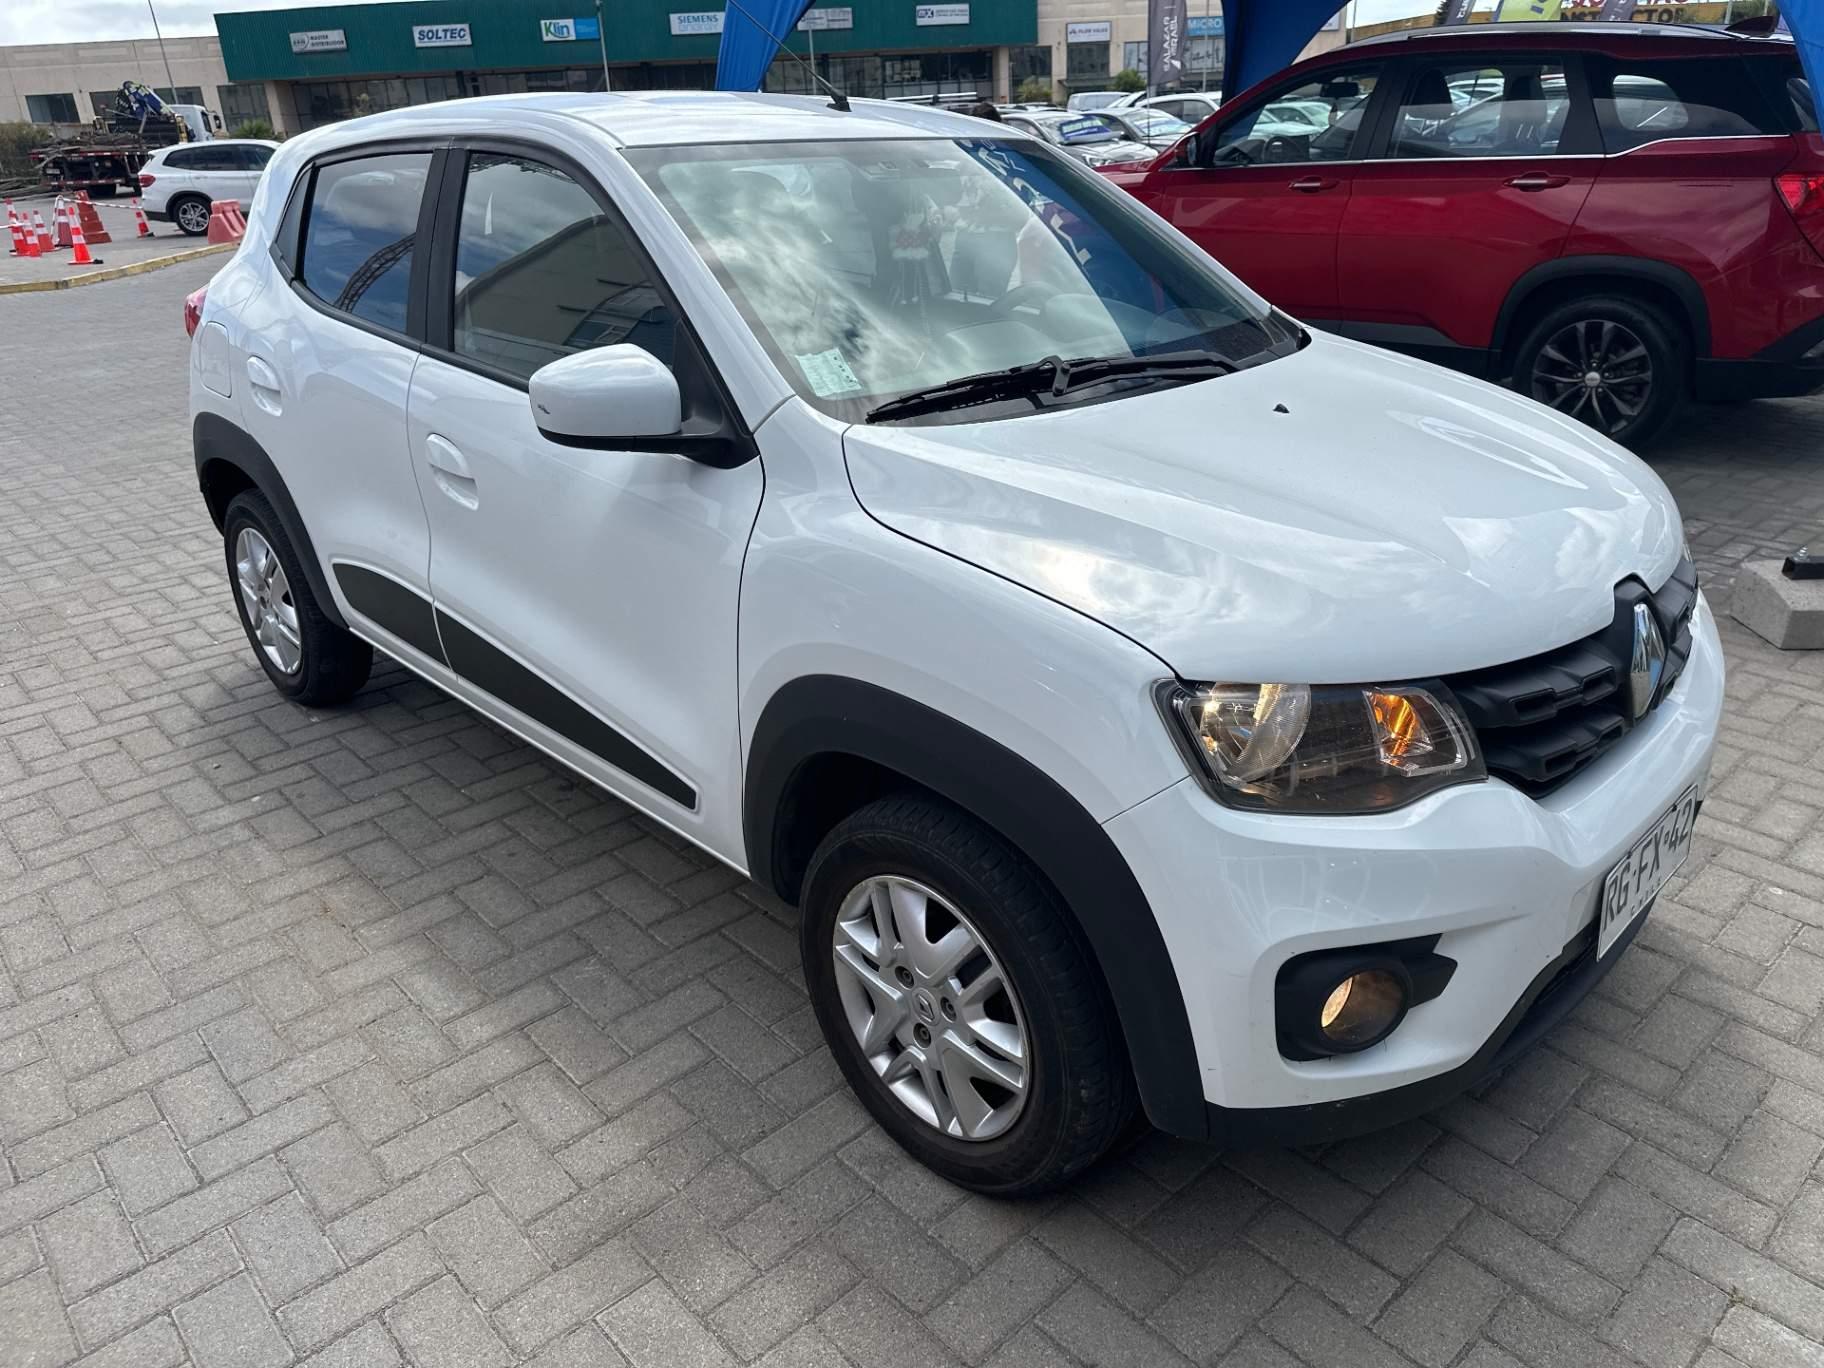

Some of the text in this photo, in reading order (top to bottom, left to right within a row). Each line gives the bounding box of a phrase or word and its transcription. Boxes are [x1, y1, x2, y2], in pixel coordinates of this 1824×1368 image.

[677, 14, 719, 24] SIEMENS
[417, 28, 467, 41] SOLTEC
[544, 21, 570, 38] Klin
